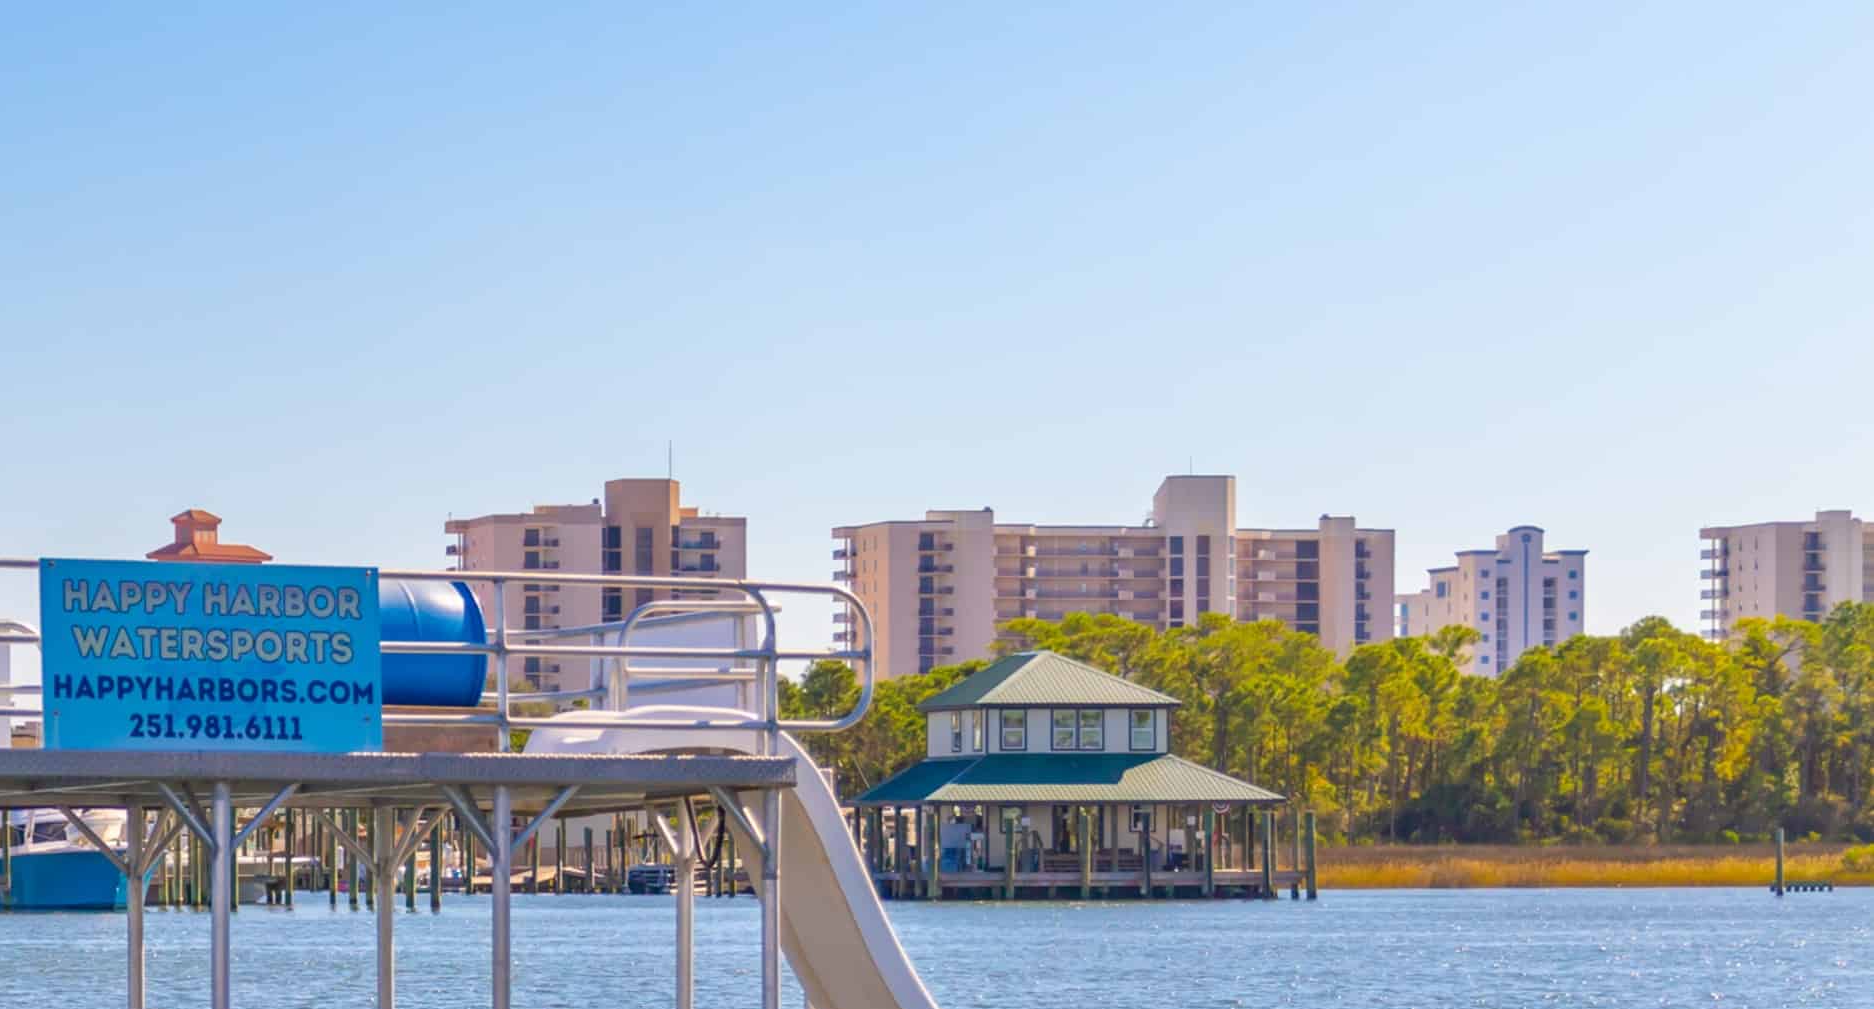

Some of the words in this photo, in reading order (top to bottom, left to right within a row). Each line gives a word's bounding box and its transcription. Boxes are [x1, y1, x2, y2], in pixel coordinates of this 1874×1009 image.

[62, 579, 192, 615] HAPPY
[202, 582, 362, 620] HARBOR
[71, 625, 353, 664] WATERSPORTS
[53, 674, 374, 705] HAPPYHARBORS.COM
[129, 714, 303, 740] 251.981.6111
